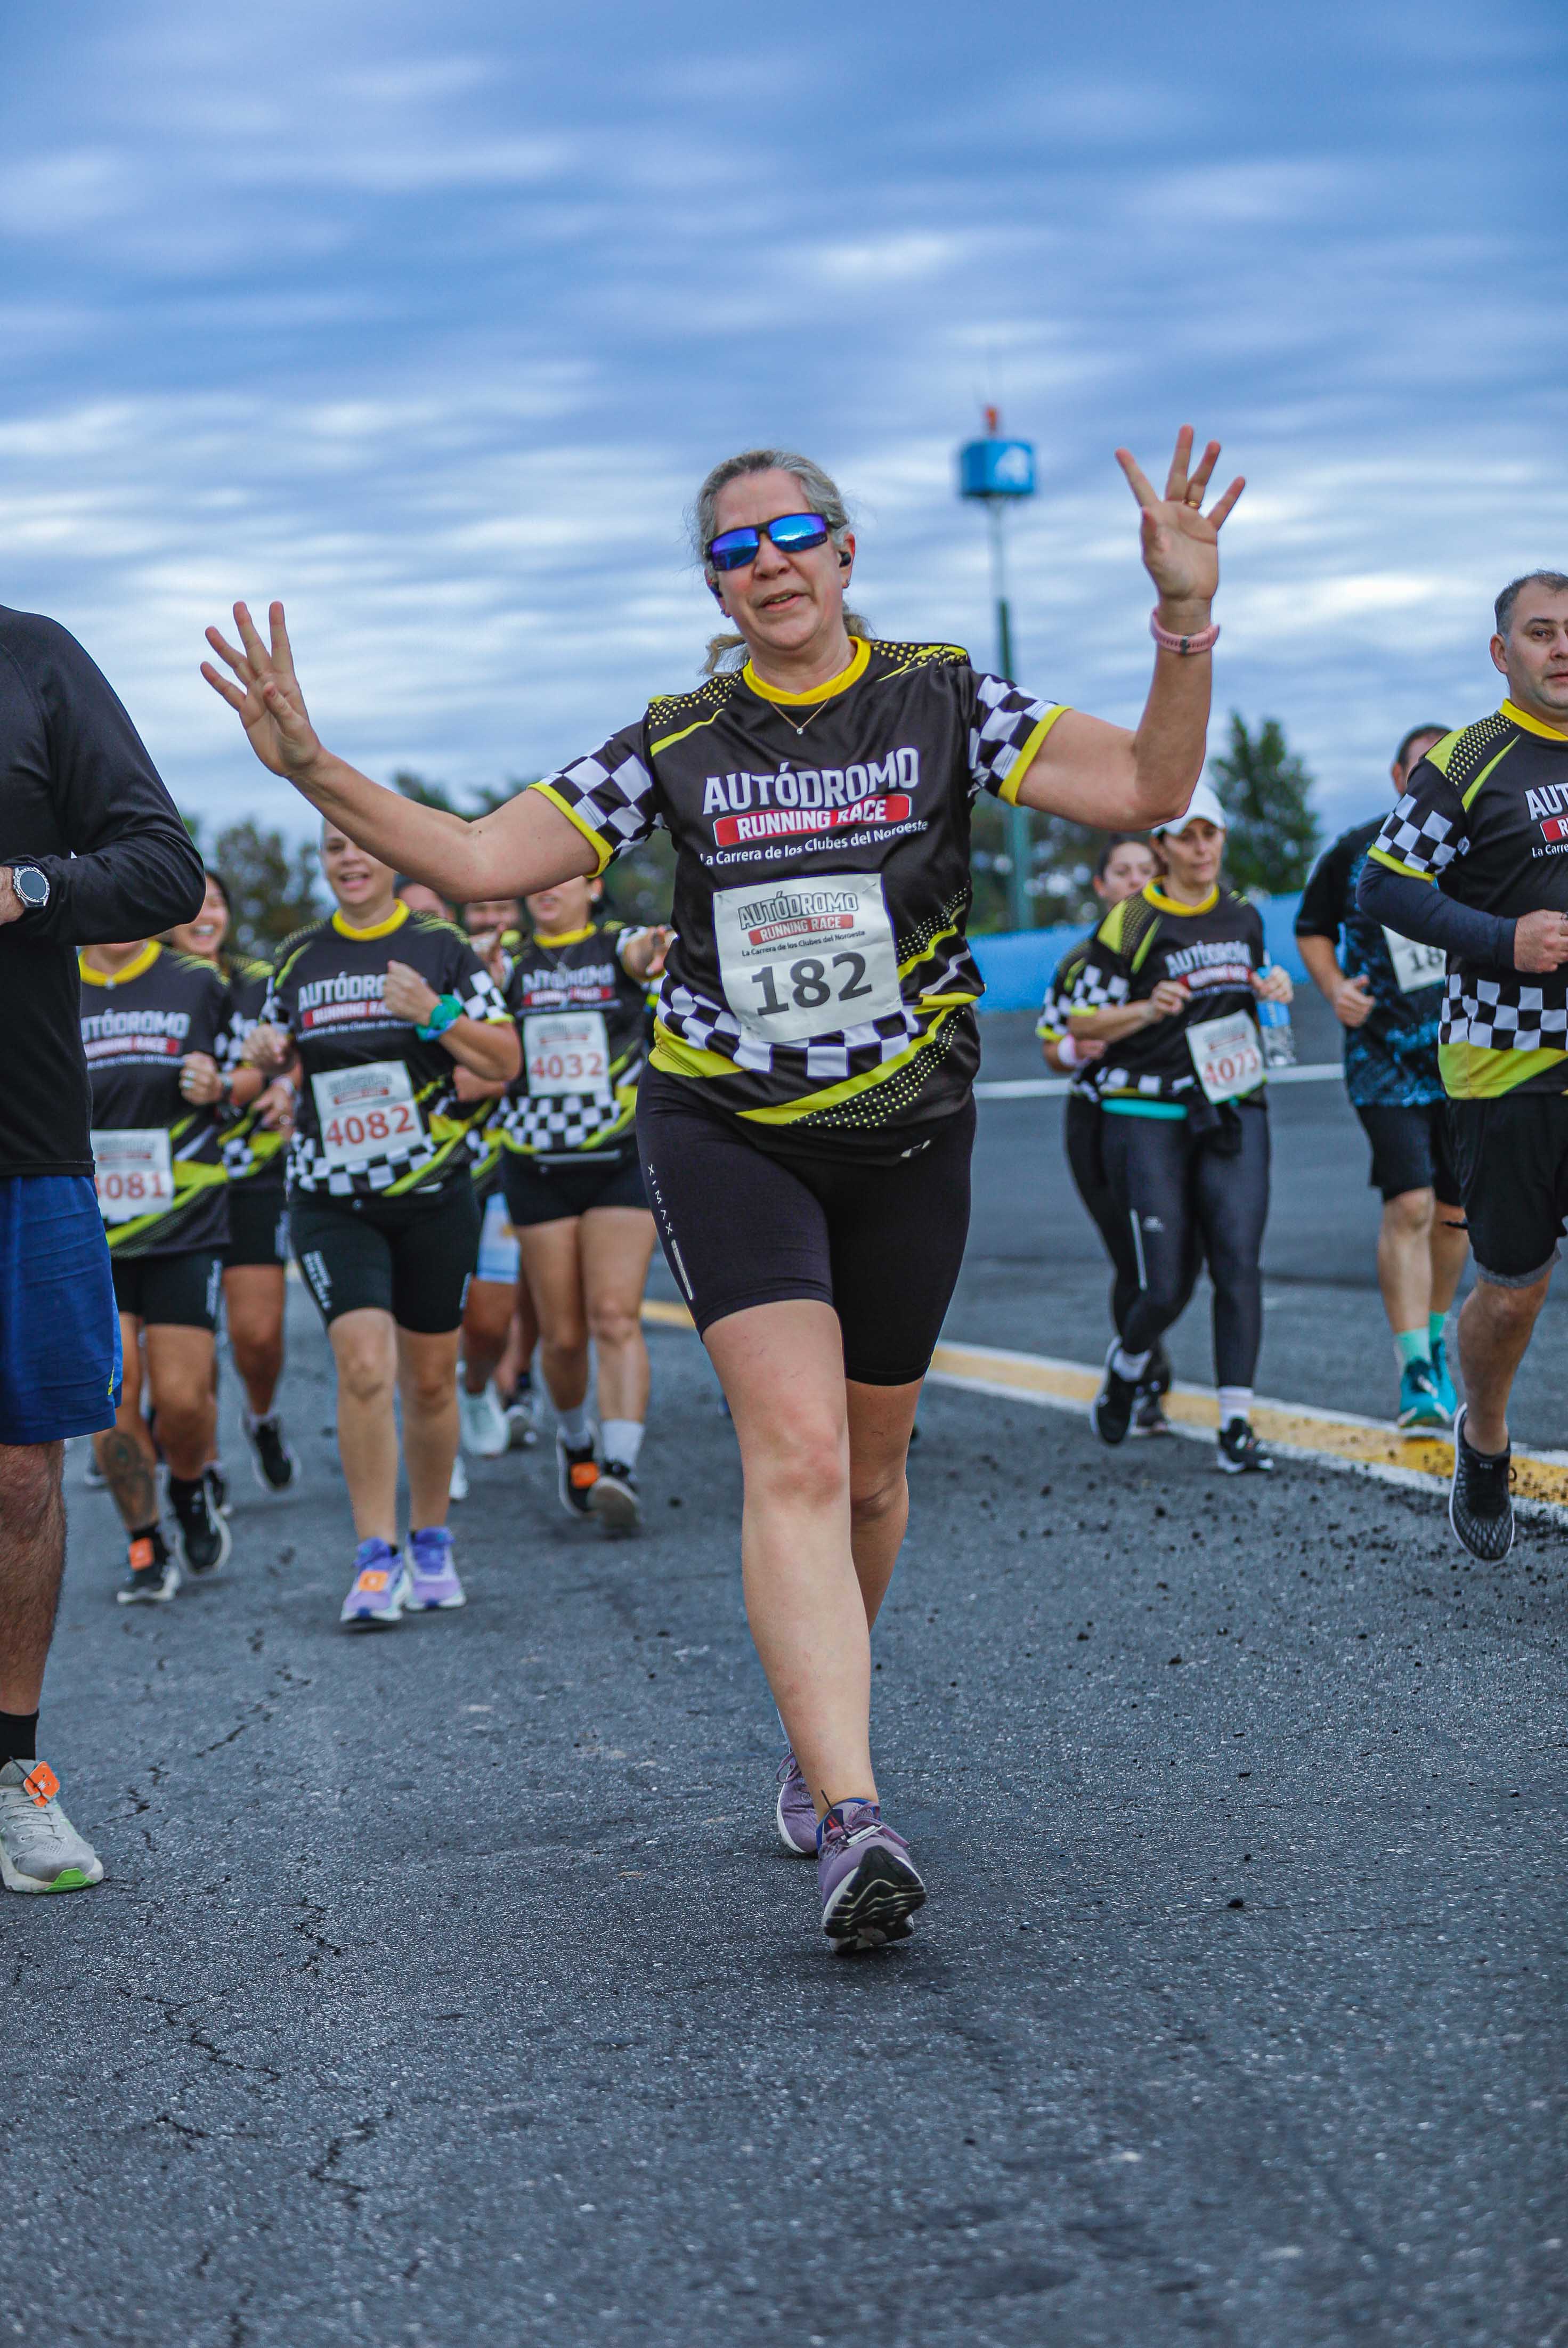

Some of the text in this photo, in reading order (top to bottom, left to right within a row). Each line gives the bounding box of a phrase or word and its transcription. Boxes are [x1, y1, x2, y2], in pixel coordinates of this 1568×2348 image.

[703, 748, 919, 815] AUTÓDROMO
[737, 799, 887, 840] RUNNING RACE
[716, 850, 762, 863] Carrera
[765, 846, 782, 859] de
[785, 845, 802, 857] los
[805, 836, 848, 852] Clubes
[851, 831, 871, 846] del
[874, 820, 928, 842] Noroeste
[1532, 847, 1543, 858] La
[737, 890, 859, 930] AUTÓDROMO
[760, 916, 841, 942] RUNNING RACE
[751, 946, 776, 955] Carrera
[298, 971, 388, 1012] AUTÓDRO
[752, 952, 872, 1015] 182
[81, 1008, 191, 1044] UTÓDROMO
[530, 1052, 603, 1079] 4032
[326, 1105, 416, 1147] 4082
[94, 1172, 167, 1199] 081
